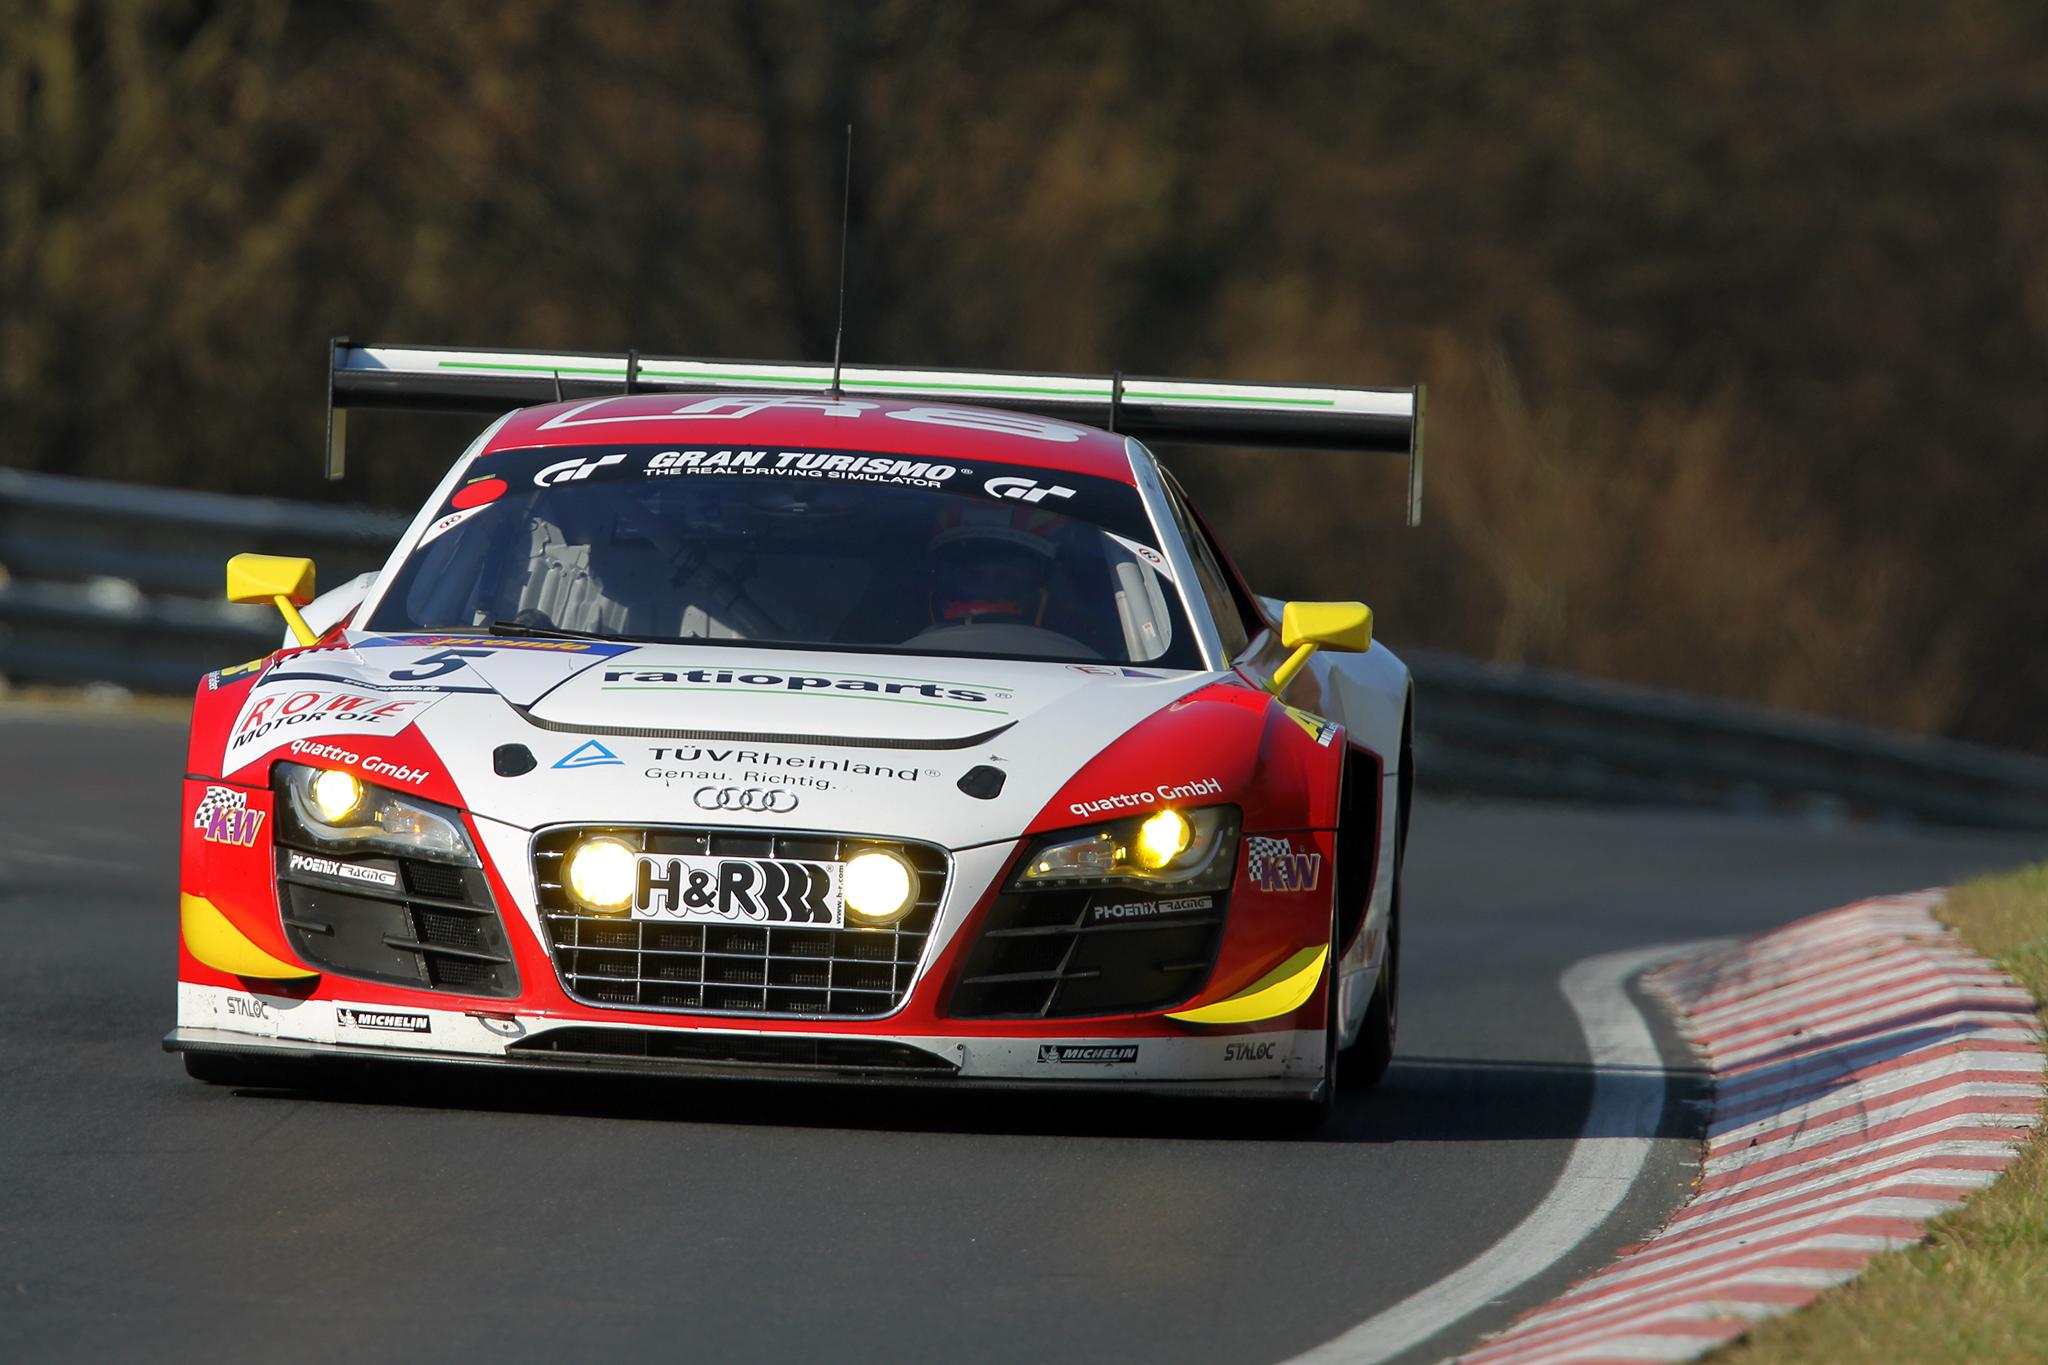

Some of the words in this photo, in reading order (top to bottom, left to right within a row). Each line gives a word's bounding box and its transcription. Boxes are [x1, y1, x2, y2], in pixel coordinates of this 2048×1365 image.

[643, 468, 682, 476] THE
[687, 466, 738, 475] REAL
[742, 466, 823, 478] DRIVING
[827, 470, 942, 489] SIMULATOR
[647, 450, 769, 468] GRAN
[776, 451, 957, 481] TURISMO
[389, 648, 498, 682] 5
[603, 669, 988, 703] ratioparts
[232, 711, 327, 750] MOTOR
[335, 712, 381, 723] OIL
[241, 693, 417, 734] ROWE
[290, 739, 359, 765] quattro
[362, 756, 430, 785] GmbH
[645, 768, 733, 782] Genau.
[743, 771, 836, 791] Richtig.
[1070, 790, 1155, 817] quattro
[1156, 777, 1223, 801] GmbH
[207, 804, 266, 849] KW
[1260, 853, 1321, 892] KW
[836, 864, 845, 925] www.h-r.com
[227, 996, 269, 1020] STALOC
[357, 1012, 428, 1029] MICHELIN
[1063, 1047, 1137, 1059] MICHELIN
[1224, 1042, 1276, 1061] STALOC
